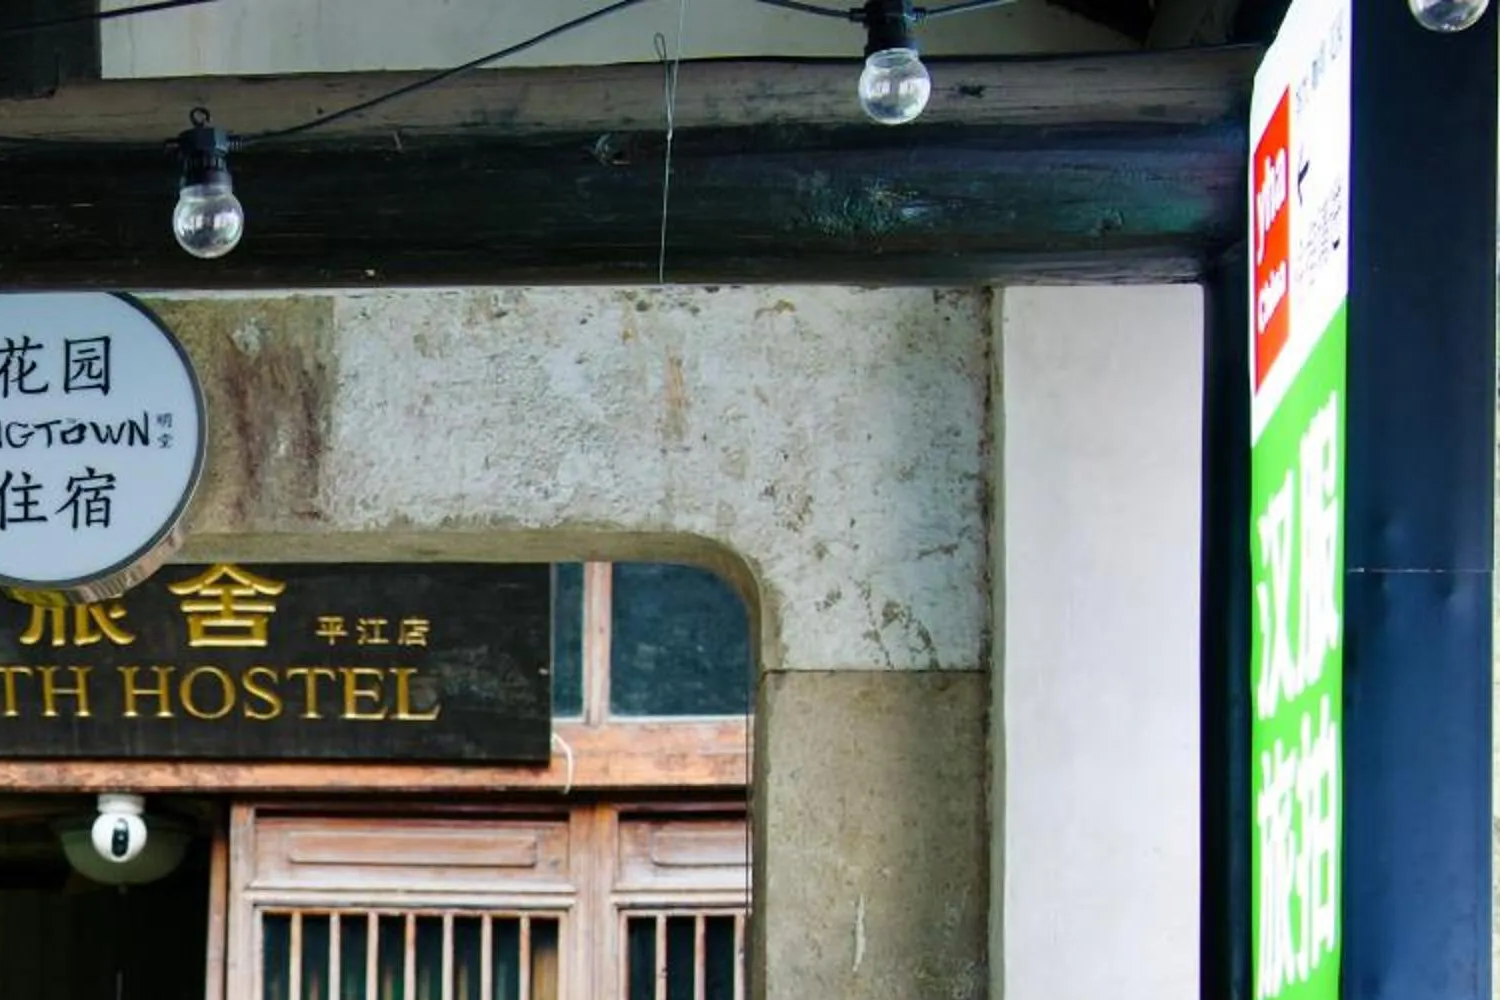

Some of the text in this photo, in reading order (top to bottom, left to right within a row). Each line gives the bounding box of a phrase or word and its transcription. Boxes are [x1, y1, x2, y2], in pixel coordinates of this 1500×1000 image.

[314, 616, 431, 647] 平江店
[116, 665, 442, 721] HOSTEL
